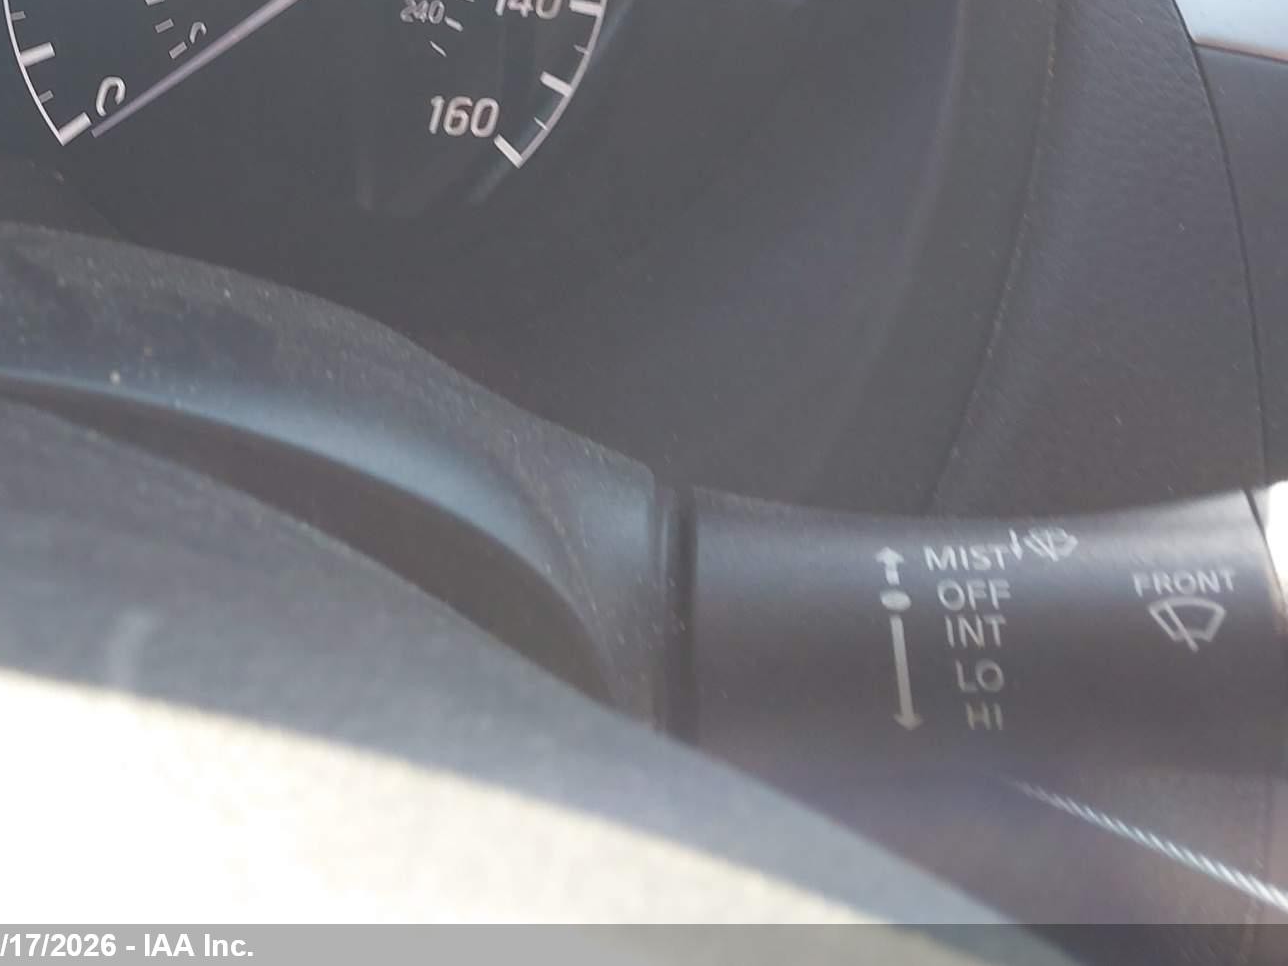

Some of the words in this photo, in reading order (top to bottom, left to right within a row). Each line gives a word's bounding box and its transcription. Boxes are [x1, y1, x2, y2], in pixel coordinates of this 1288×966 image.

[401, 0, 444, 23] 240
[430, 96, 498, 137] 160
[925, 546, 1009, 570] MIST
[937, 578, 1010, 608] OFF
[1133, 568, 1236, 595] FRONT
[945, 615, 1005, 646] INT
[956, 661, 1004, 691] LO
[966, 703, 1002, 730] HI
